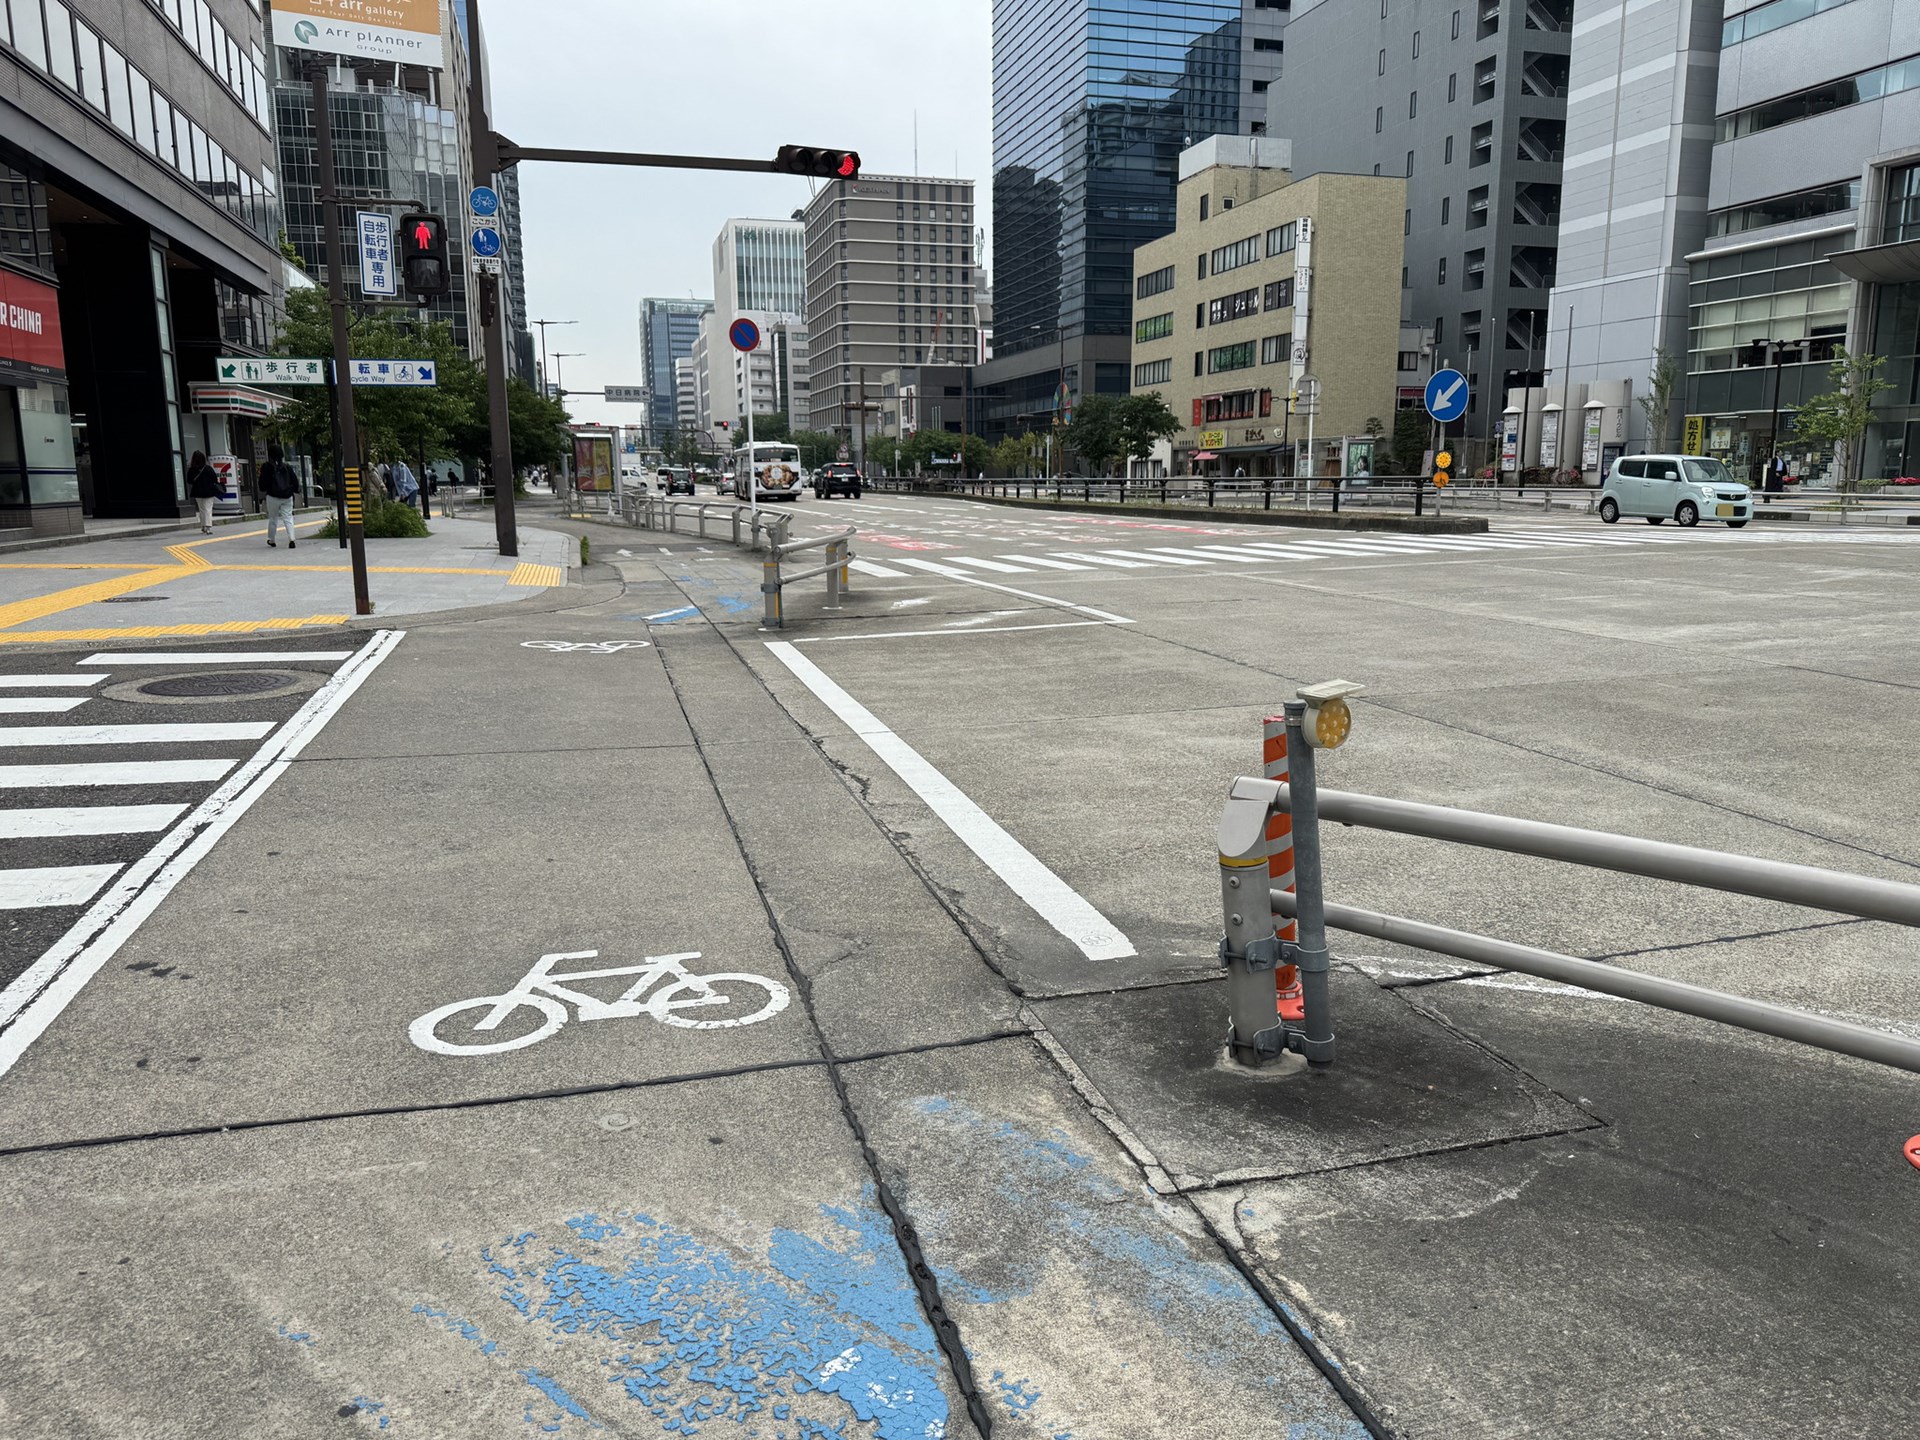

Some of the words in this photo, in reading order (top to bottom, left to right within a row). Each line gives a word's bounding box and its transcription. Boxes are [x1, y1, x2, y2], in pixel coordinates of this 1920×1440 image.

[365, 6, 404, 19] gallery
[472, 218, 497, 226] ここから
[363, 220, 376, 260] 自転車
[376, 221, 388, 262] 歩行者
[371, 261, 385, 288] 専用
[9, 305, 42, 335] CHINA
[265, 361, 319, 374] 歩行者
[358, 363, 390, 374] 転車
[295, 374, 311, 383] Way
[350, 375, 369, 383] cycle
[371, 375, 386, 383] Way
[1712, 440, 1729, 448] くすり
